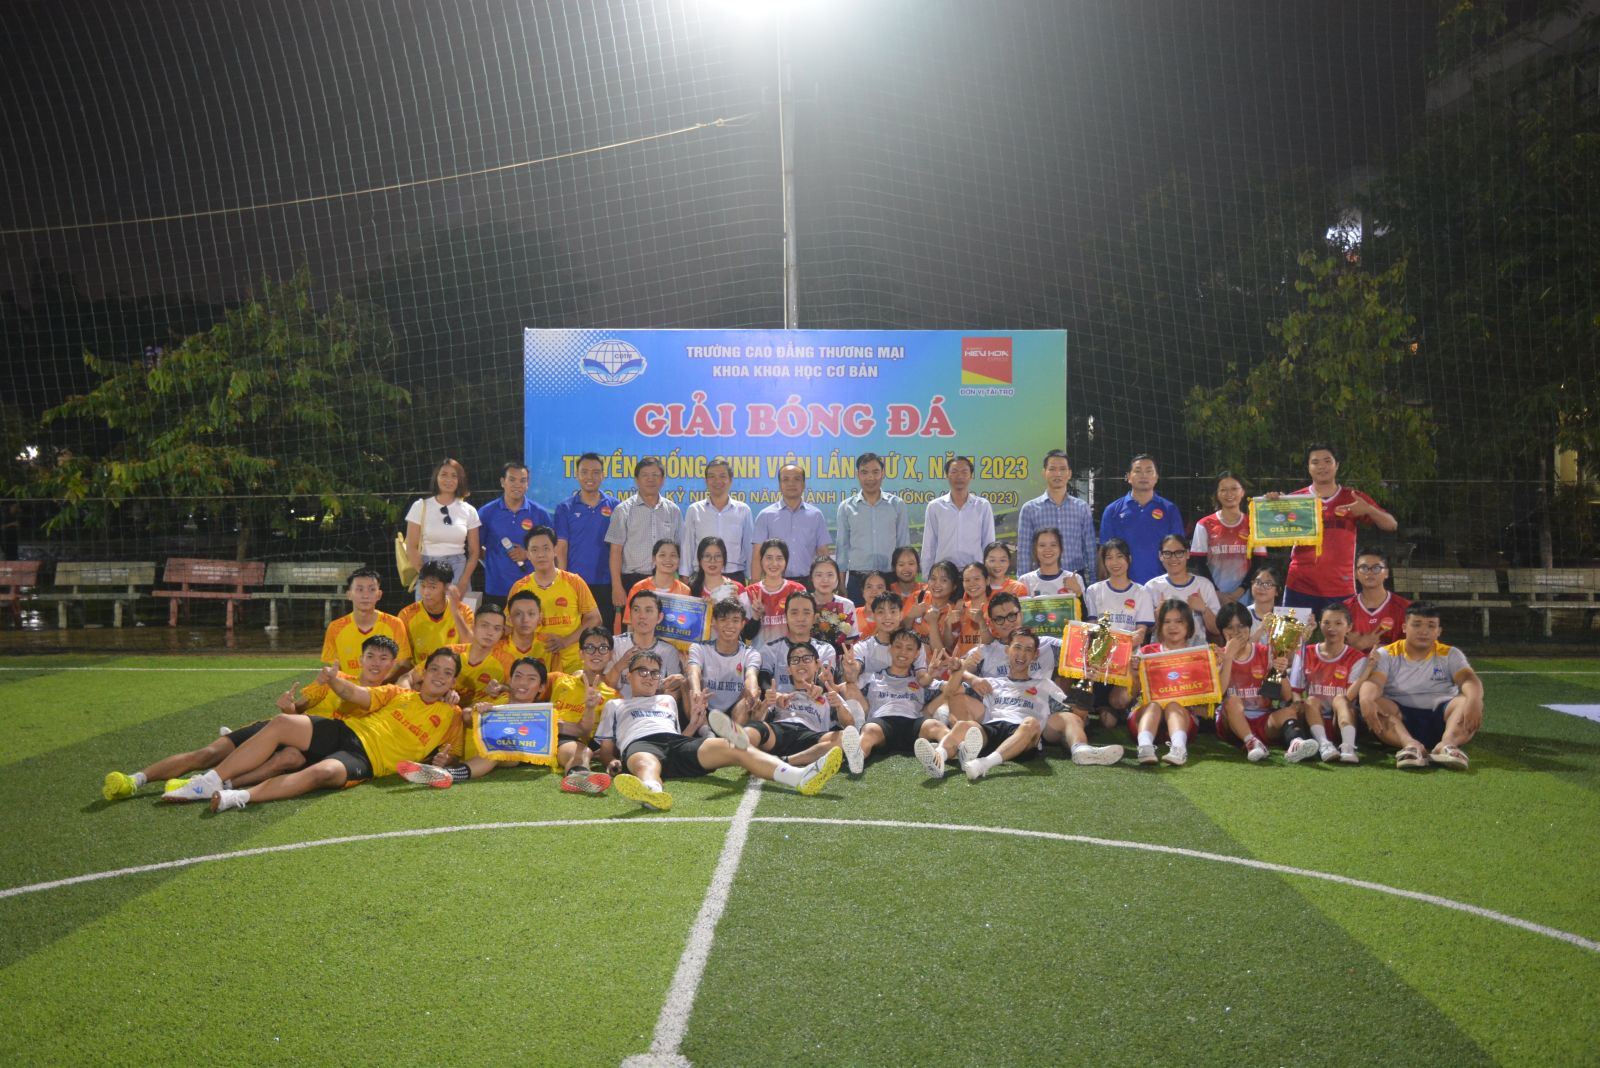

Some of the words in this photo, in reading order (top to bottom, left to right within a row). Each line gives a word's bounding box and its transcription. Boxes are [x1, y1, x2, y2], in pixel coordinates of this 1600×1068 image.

[686, 343, 741, 359] TRƯỜNG
[745, 345, 773, 359] CAO
[818, 345, 874, 359] THƯƠNG
[877, 346, 905, 361] MẠI
[712, 365, 750, 377] KHOA
[753, 365, 791, 377] KHOA
[794, 365, 822, 380] HỌC
[826, 364, 846, 378] CƠ
[849, 362, 879, 378] BẢN
[634, 390, 736, 437] GIẢI
[746, 394, 876, 437] BÓNG
[886, 395, 956, 438] ĐÁ
[562, 448, 637, 478] TYỀN
[817, 448, 855, 479] LẦN
[903, 455, 923, 481] X,
[980, 455, 1028, 479] 2023
[750, 488, 783, 503] NĂM
